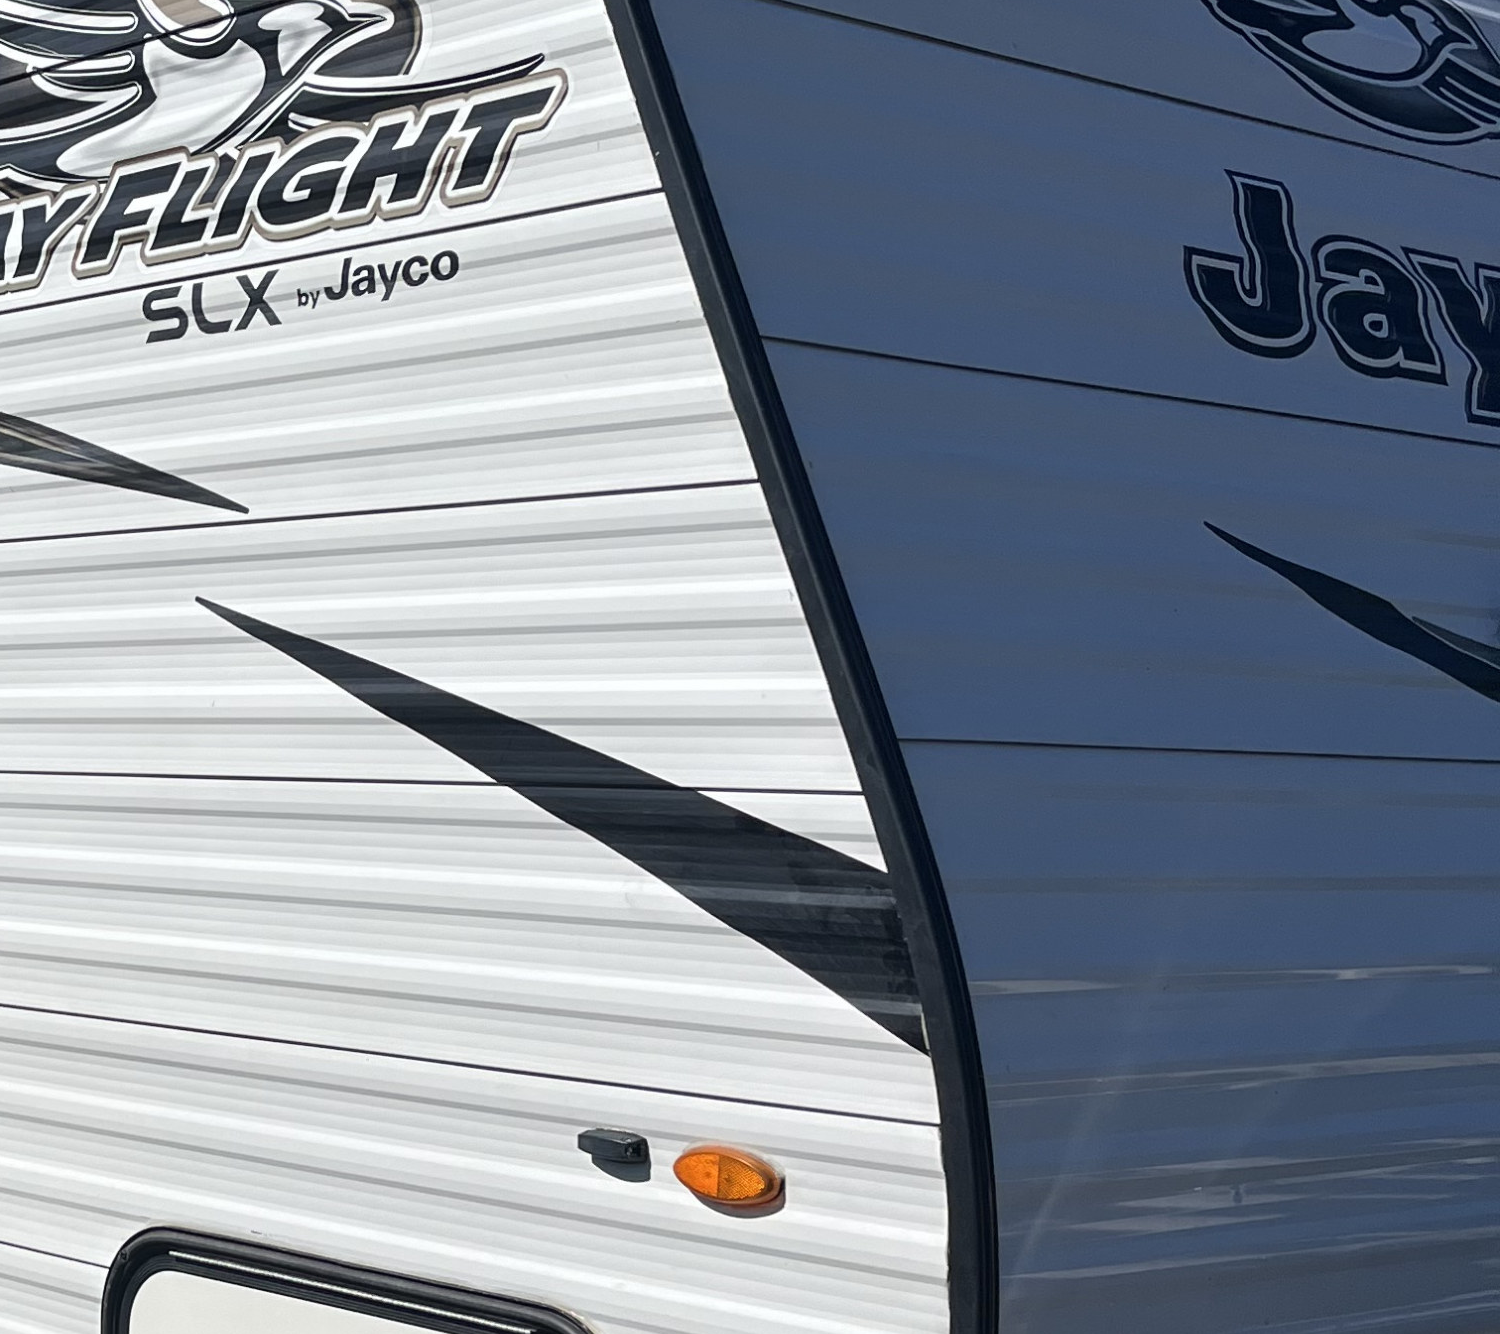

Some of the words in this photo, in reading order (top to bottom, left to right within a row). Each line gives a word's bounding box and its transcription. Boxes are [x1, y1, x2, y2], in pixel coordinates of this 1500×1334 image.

[72, 68, 569, 280] FLIGHT
[142, 269, 282, 344] SLX
[296, 287, 321, 309] by
[324, 249, 460, 302] Jayco
